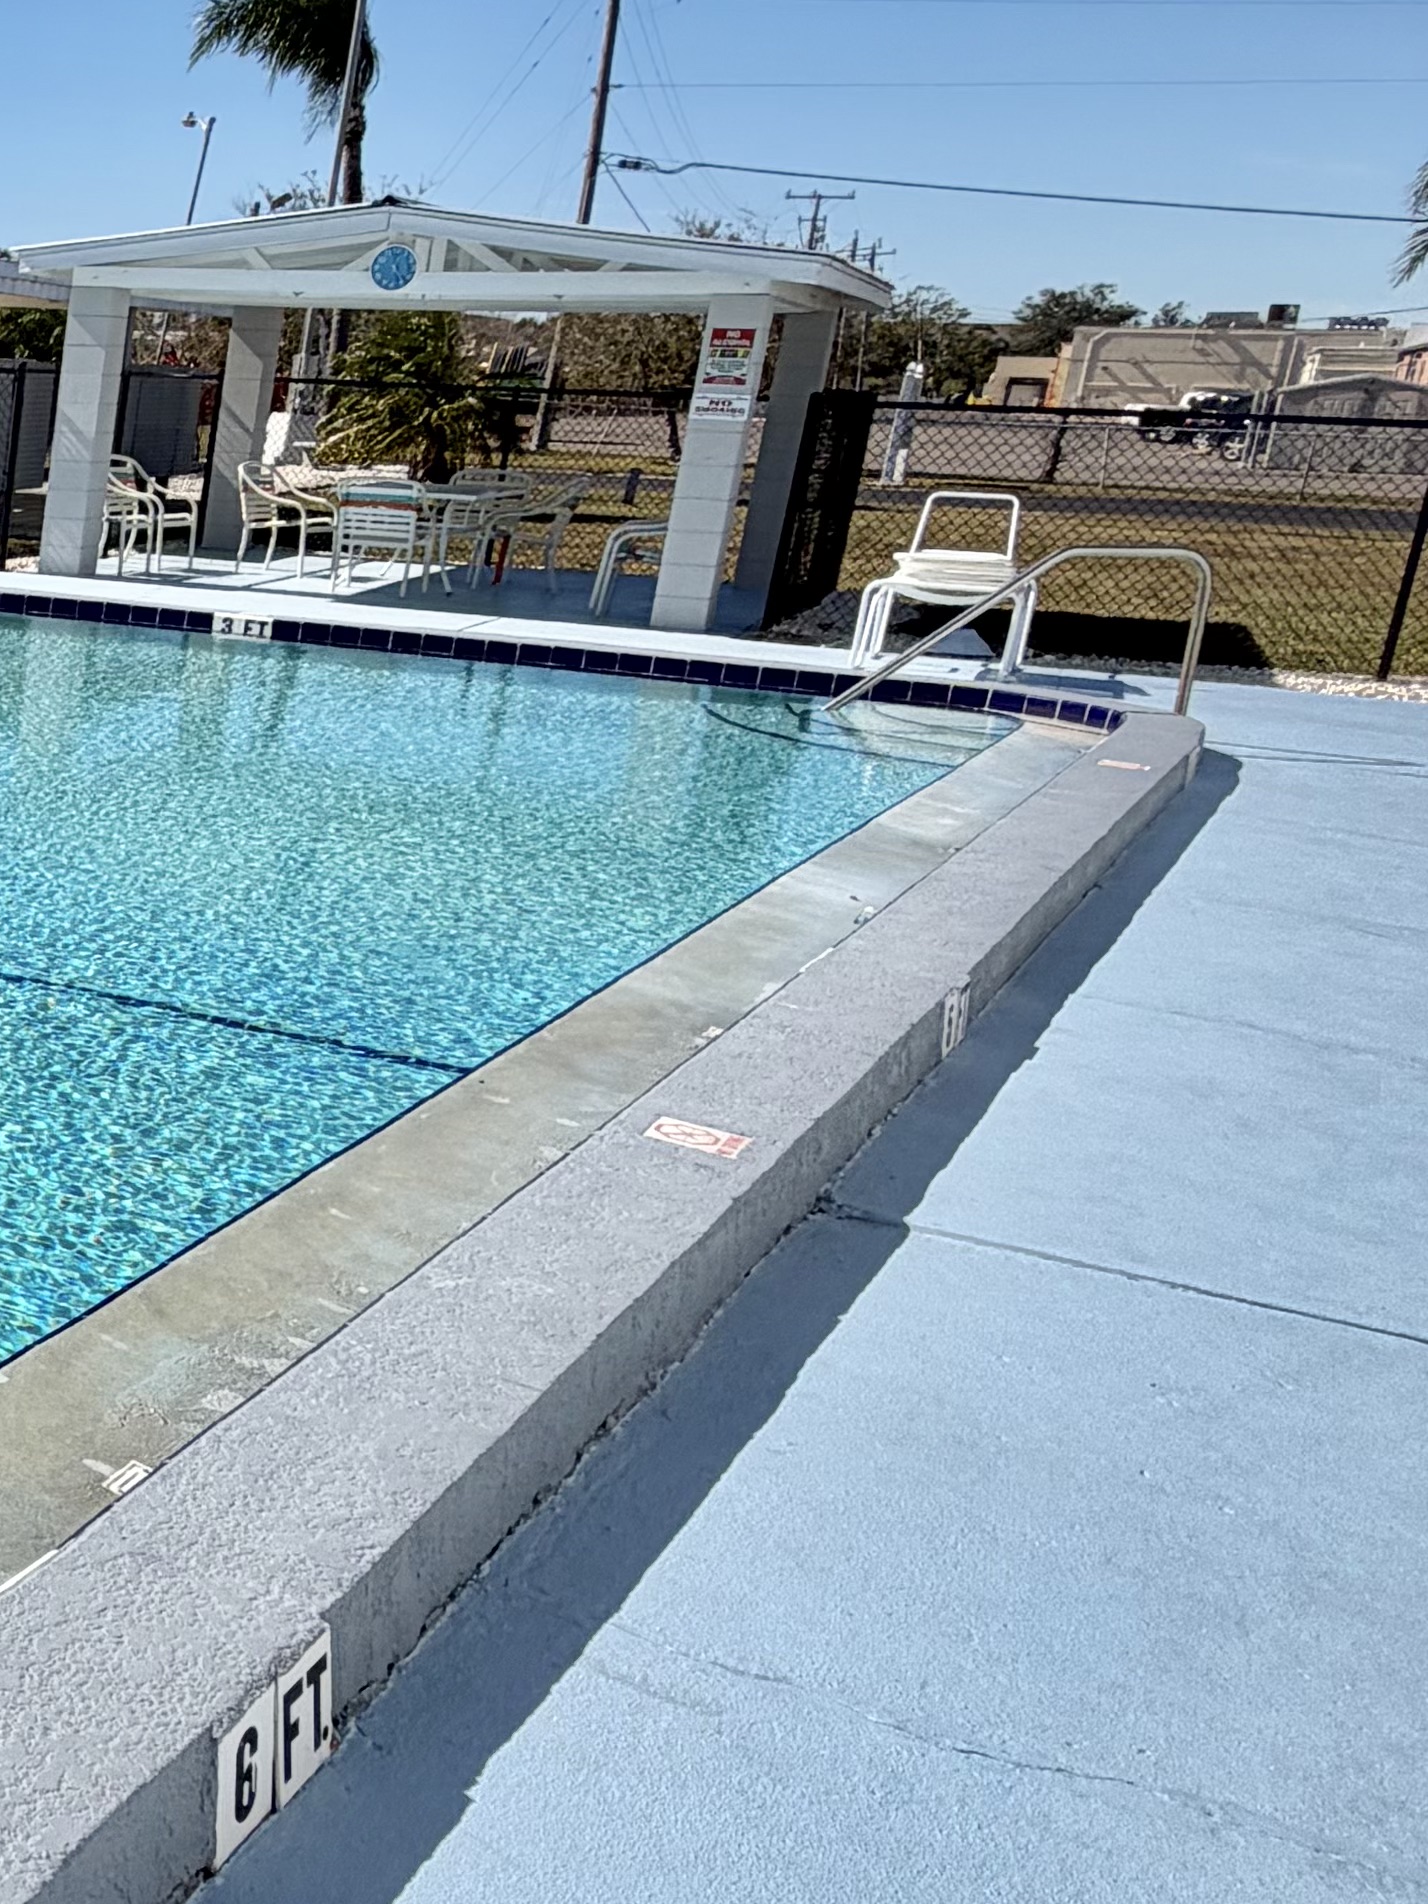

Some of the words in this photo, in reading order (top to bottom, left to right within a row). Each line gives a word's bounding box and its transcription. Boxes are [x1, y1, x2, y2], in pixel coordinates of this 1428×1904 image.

[695, 405, 746, 414] SMOKING
[220, 617, 234, 634] 3
[235, 1726, 258, 1824] 6
[283, 1653, 328, 1785] FT.
